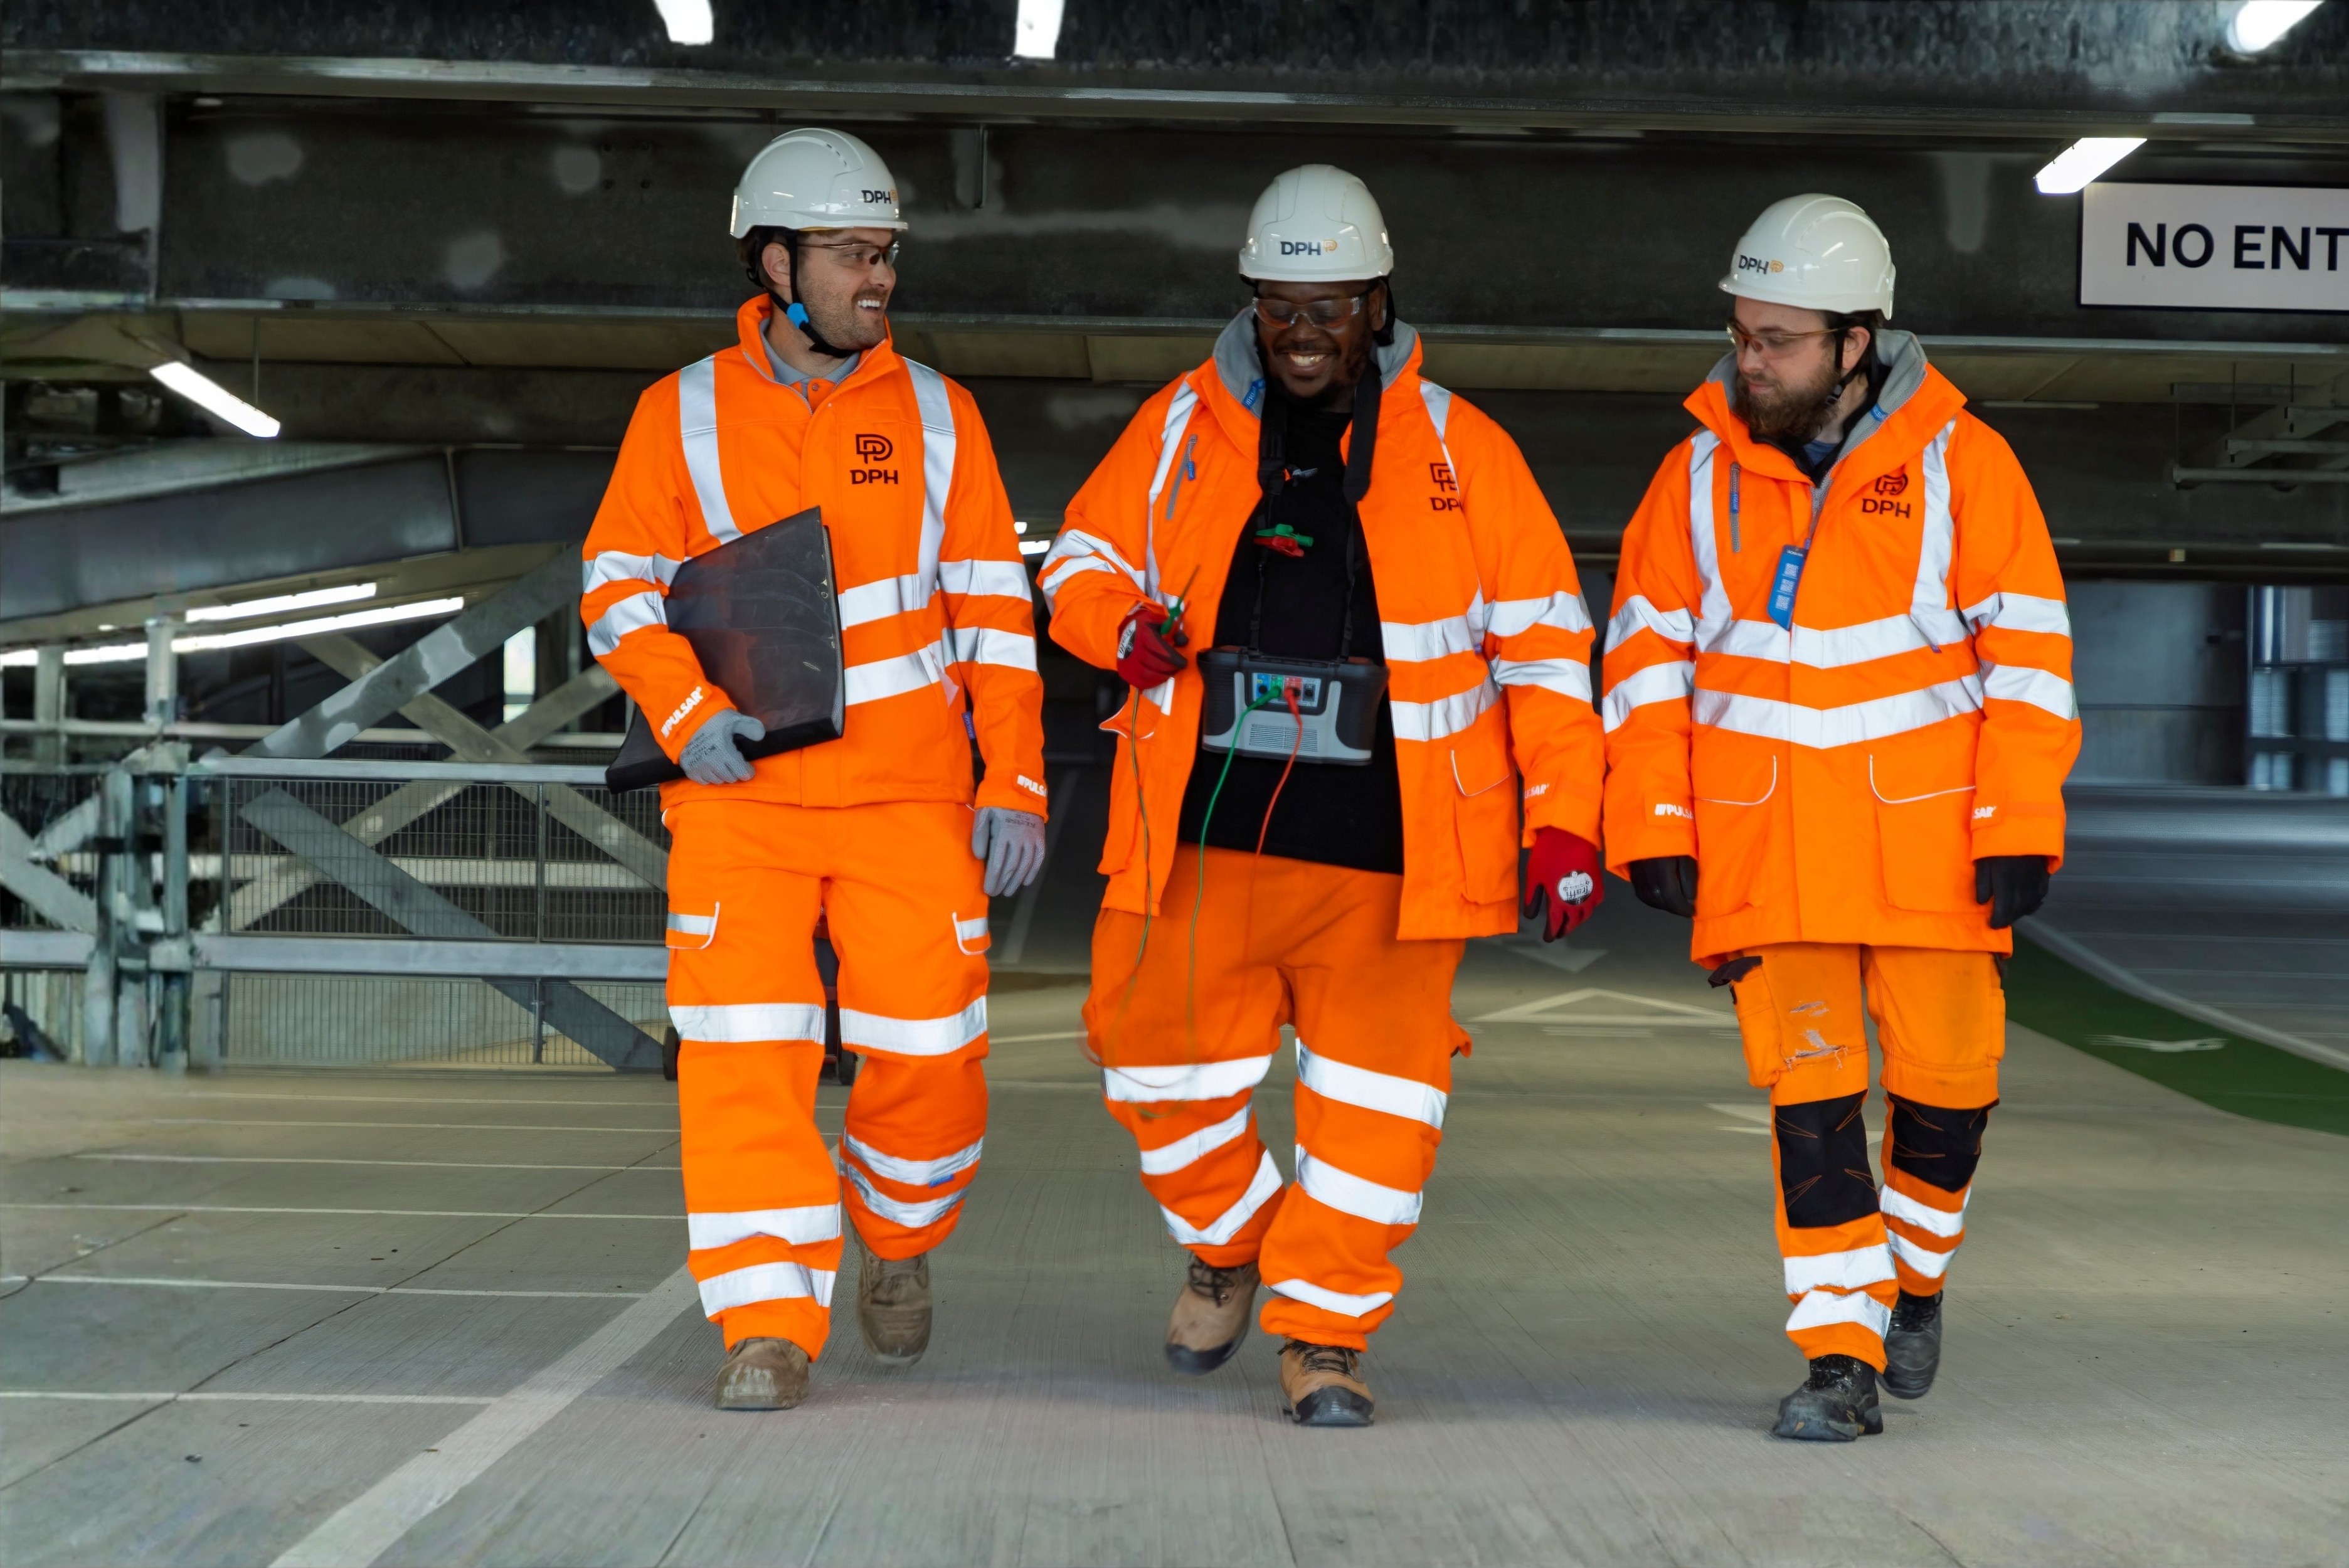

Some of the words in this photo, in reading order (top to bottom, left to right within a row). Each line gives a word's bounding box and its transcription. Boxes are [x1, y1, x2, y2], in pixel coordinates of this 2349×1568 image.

[861, 190, 891, 204] DPH
[1280, 241, 1321, 255] DPH
[2127, 222, 2214, 268] NO
[2234, 225, 2349, 271] ENT
[1738, 255, 1769, 274] DPH
[849, 469, 898, 485] DPH
[1862, 498, 1911, 519] DPH
